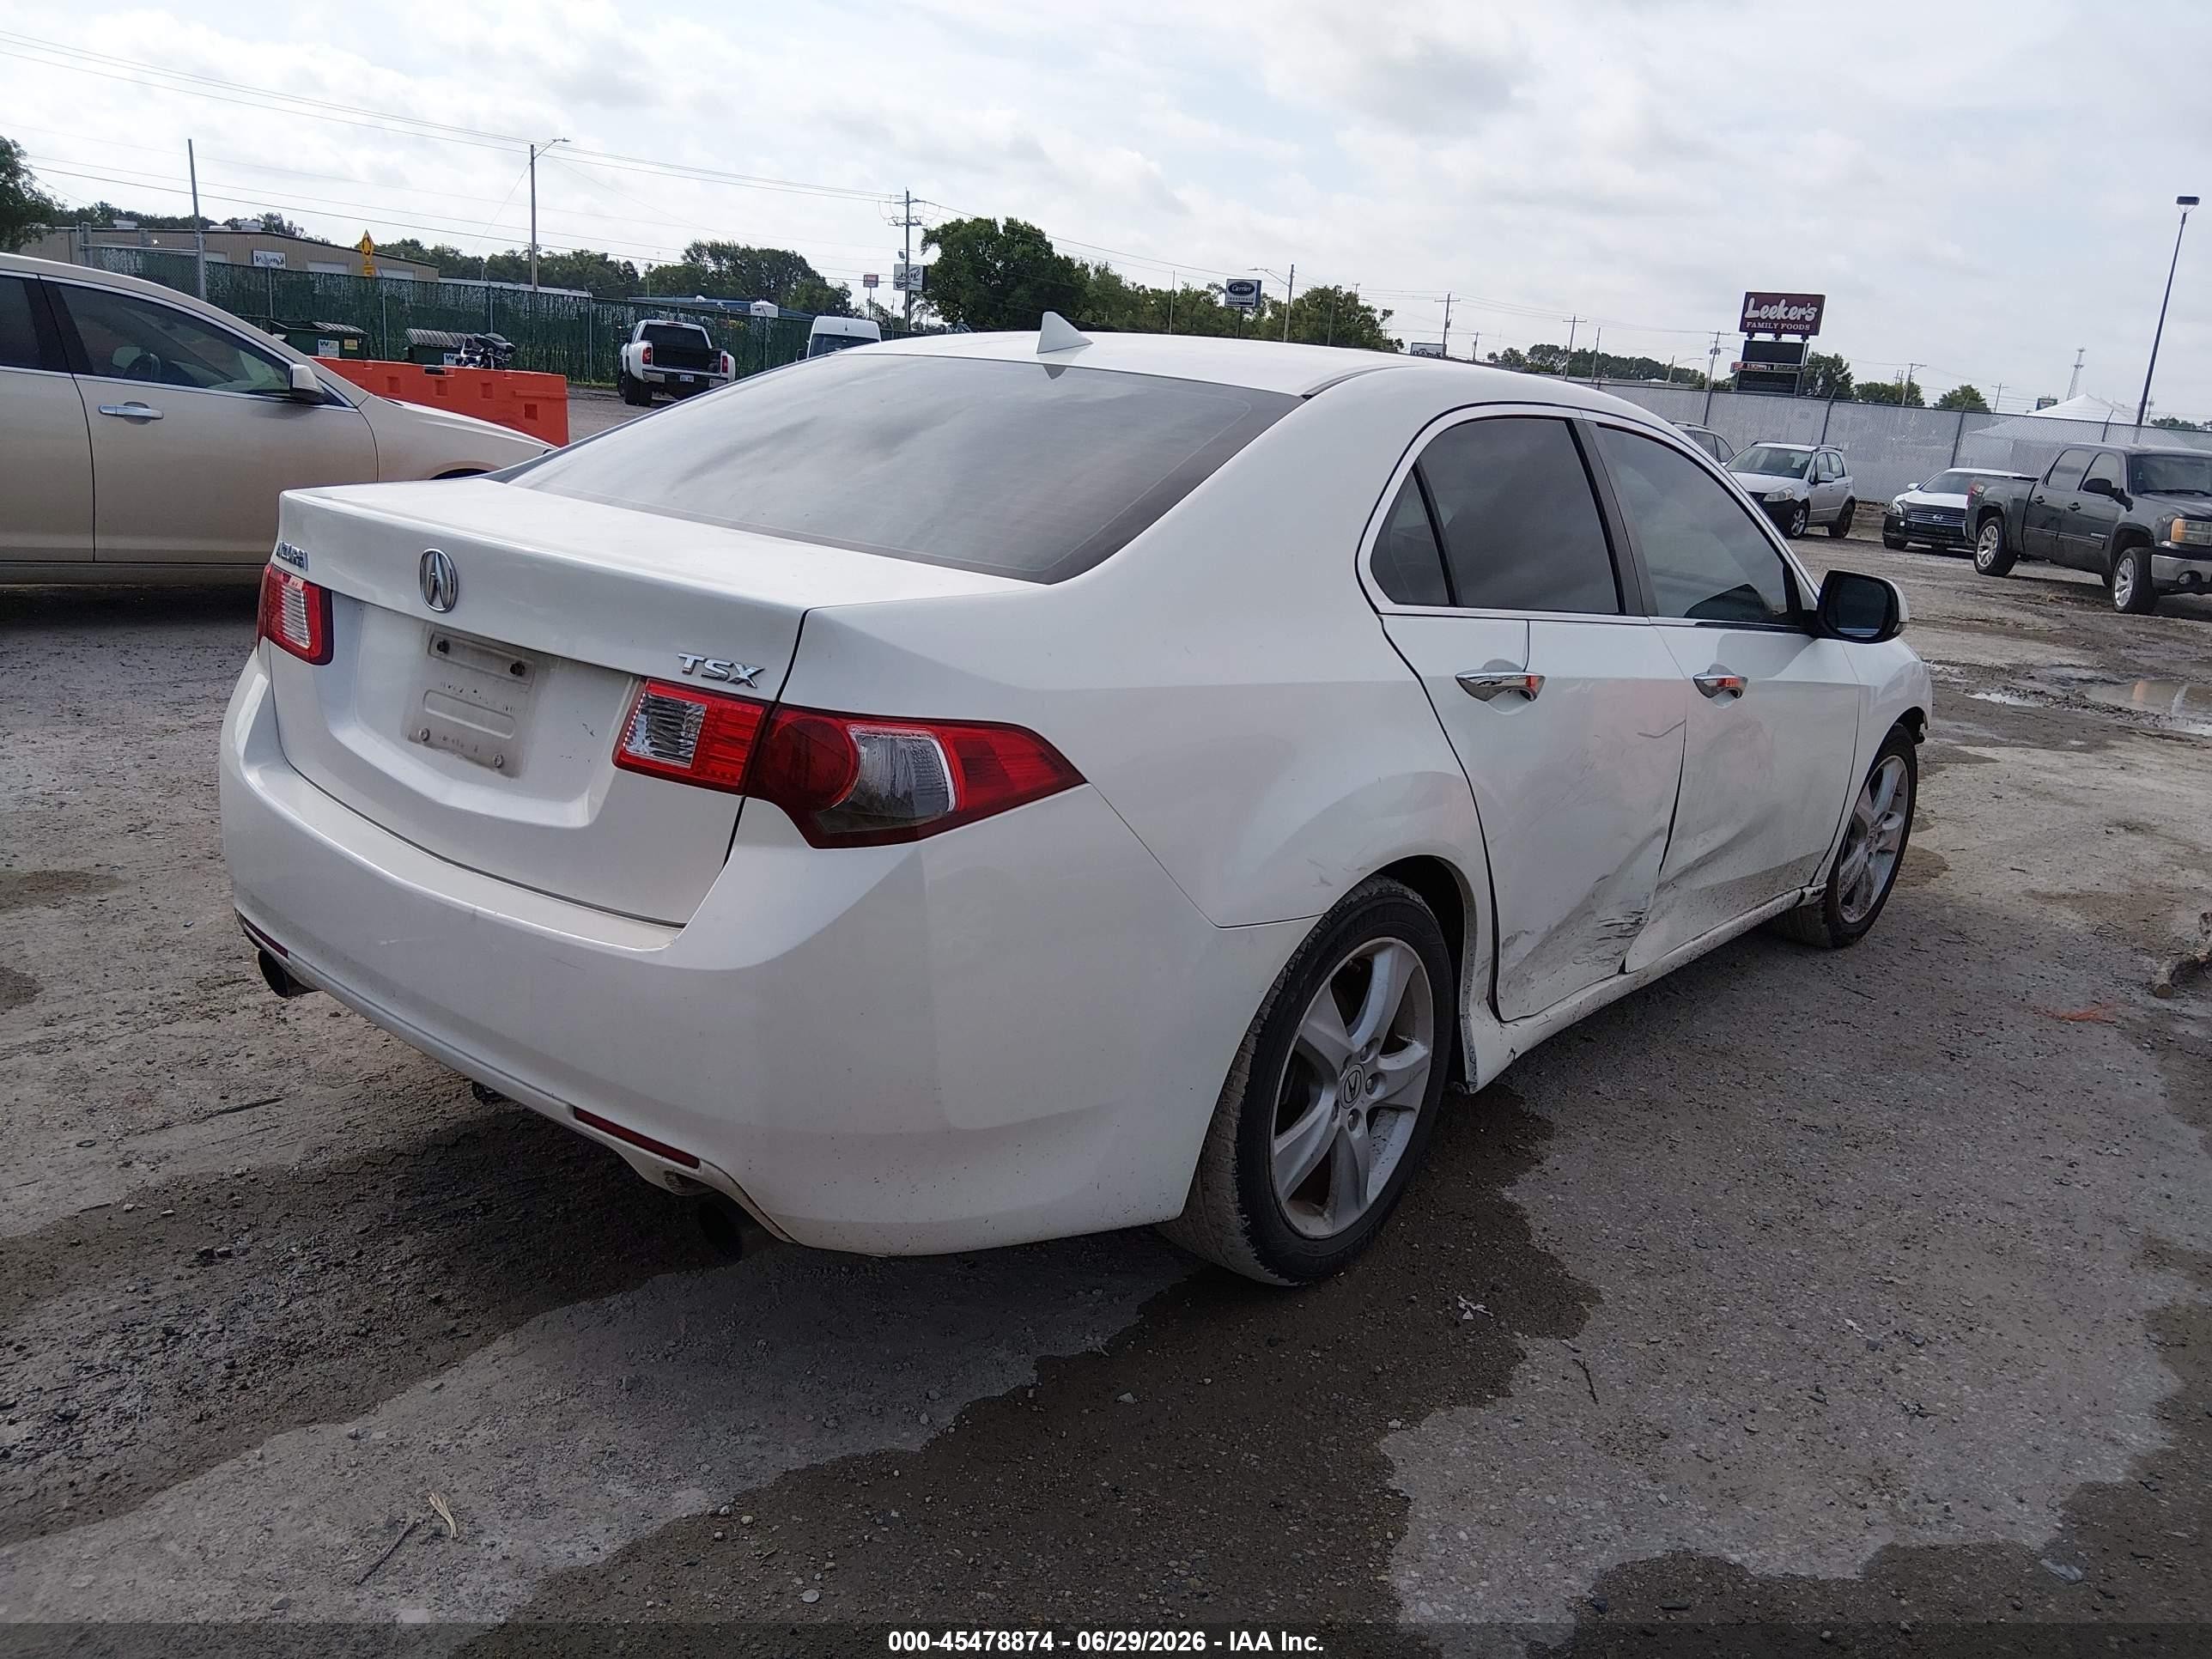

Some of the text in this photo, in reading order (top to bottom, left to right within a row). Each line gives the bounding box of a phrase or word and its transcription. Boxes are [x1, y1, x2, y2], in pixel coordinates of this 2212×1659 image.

[1744, 297, 1818, 322] Leeker's
[1780, 322, 1811, 331] FOODS
[678, 653, 765, 689] TSX
